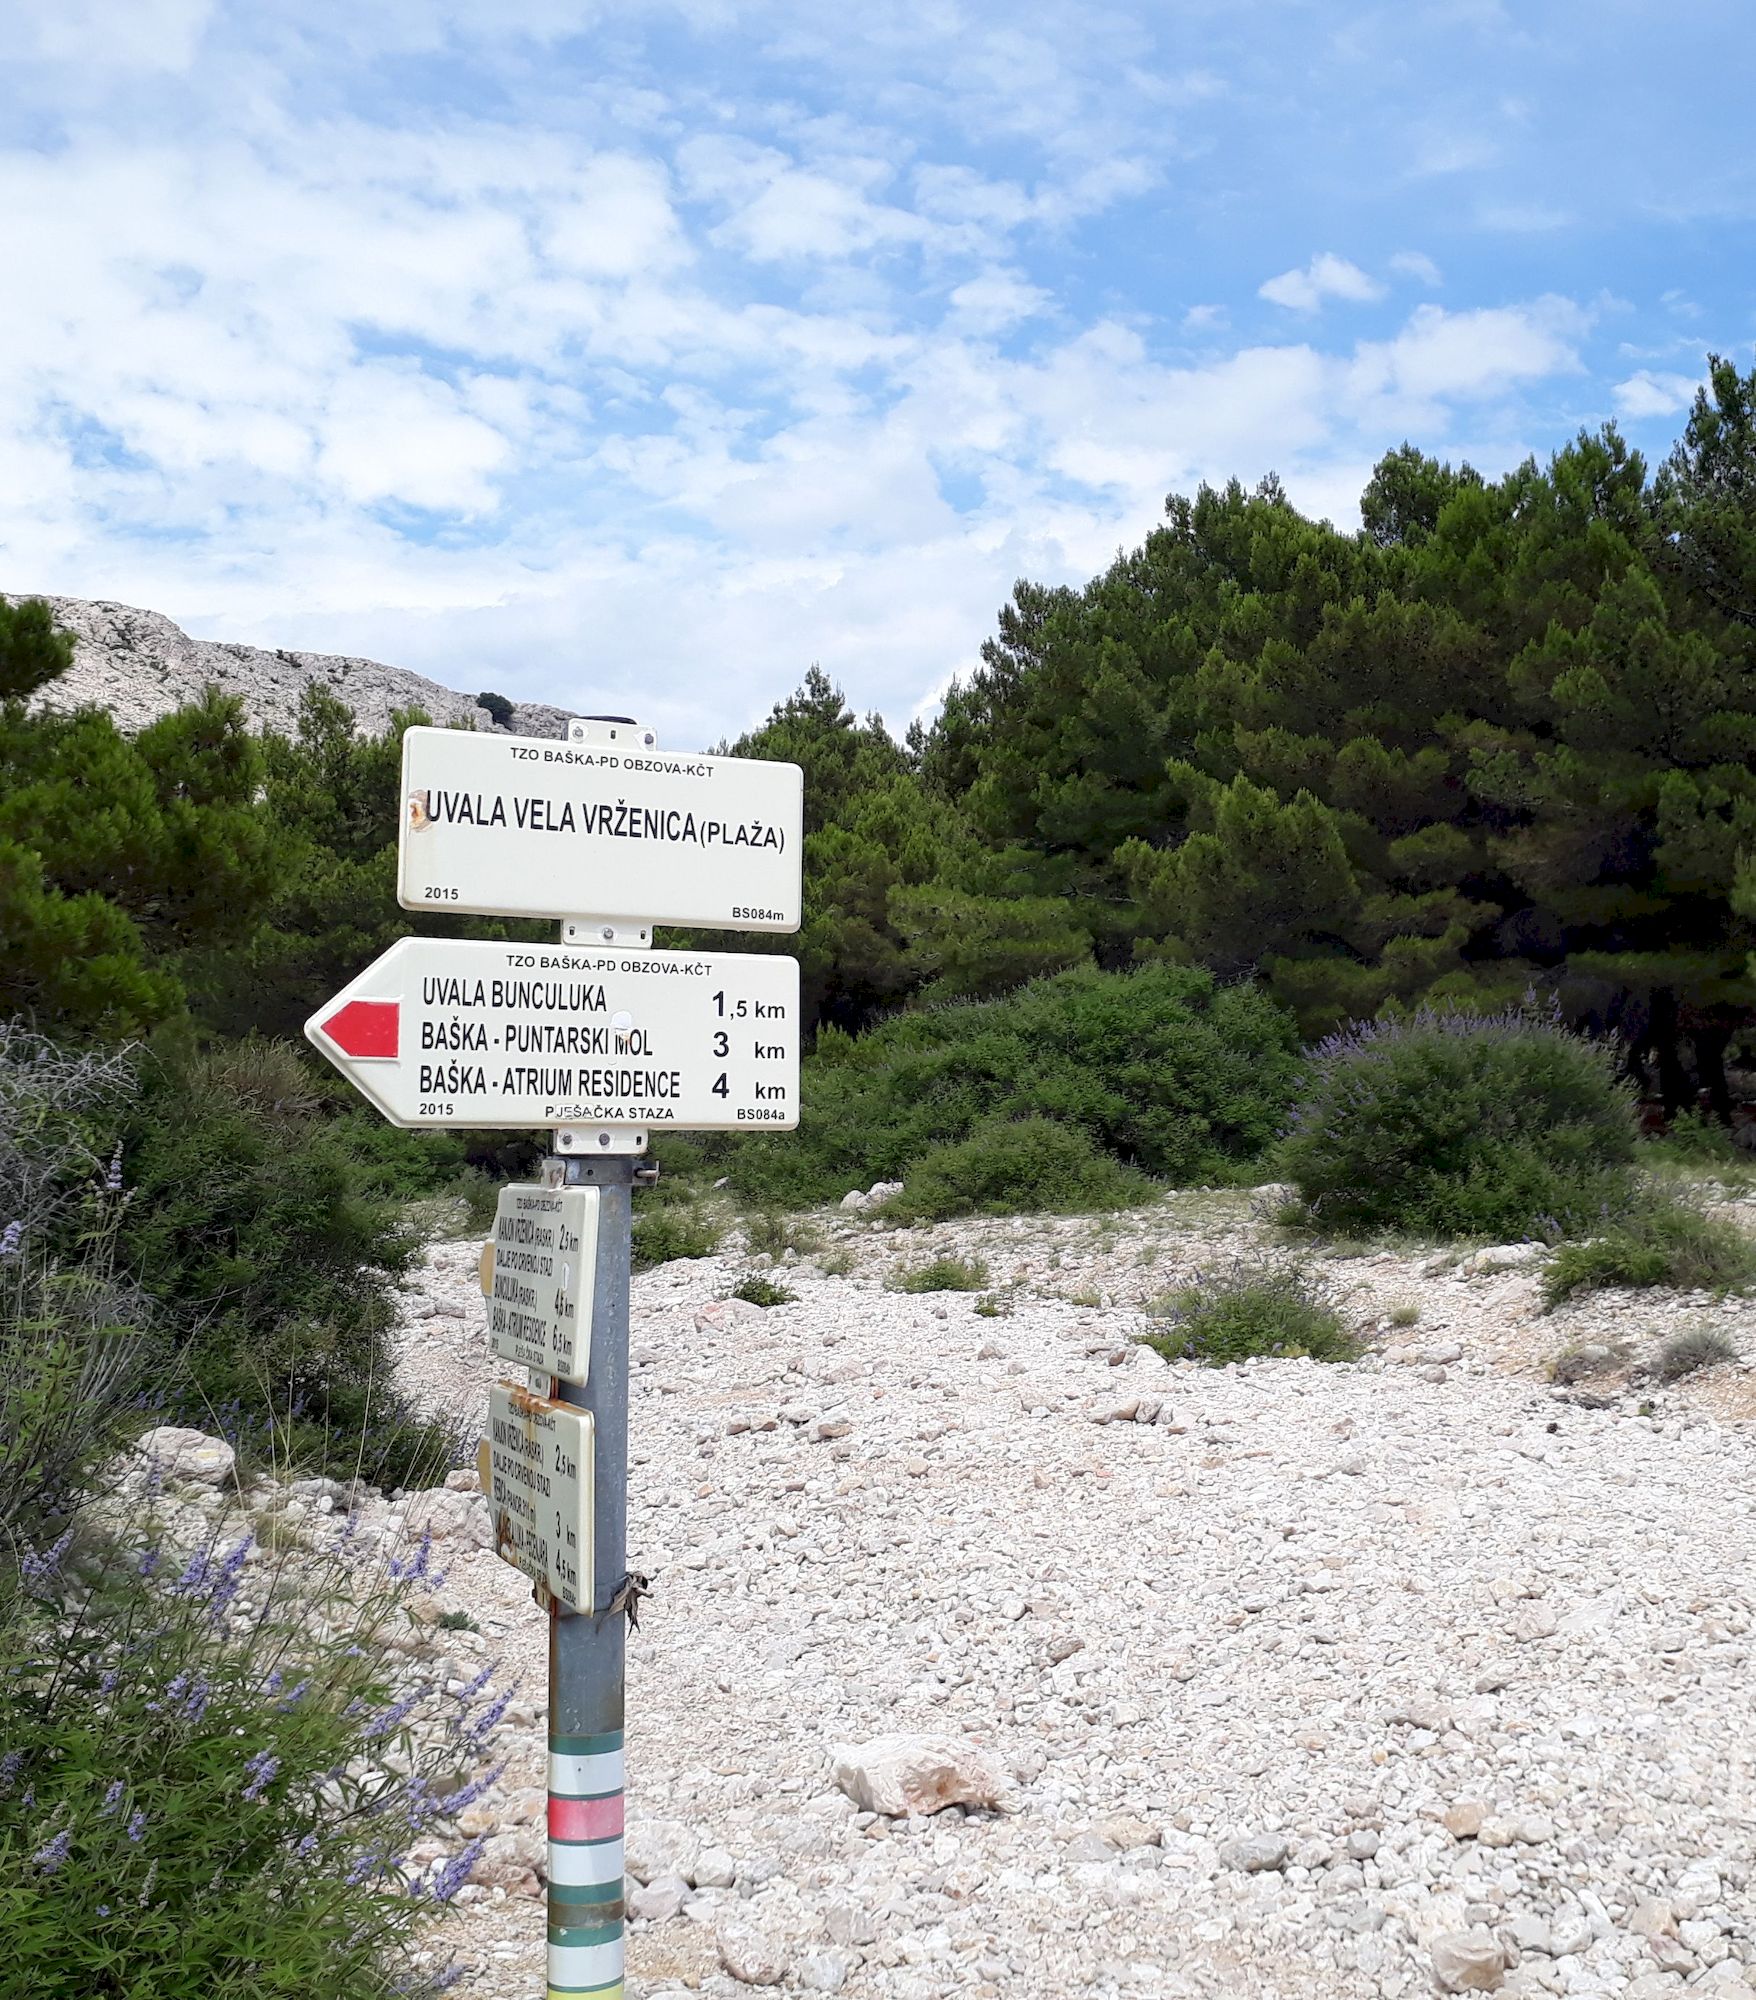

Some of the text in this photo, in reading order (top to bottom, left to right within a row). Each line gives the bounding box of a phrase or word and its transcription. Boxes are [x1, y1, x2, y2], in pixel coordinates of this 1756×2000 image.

[510, 747, 714, 777] TZO BAŠKA-PD OBZOVA-KČT
[425, 789, 507, 828] UVALA
[513, 797, 576, 833] VELA
[424, 886, 459, 900] 2015
[732, 906, 784, 921] BS084m
[506, 954, 713, 976] TZO BAŠKA-PD OBZOVA-KČT
[423, 976, 785, 1021] UVALA BUNCULUKA 1,5 km
[421, 1015, 489, 1052] BAŠKA
[505, 1024, 609, 1055] PUNTARSKI
[713, 1031, 730, 1058] 3
[754, 1041, 785, 1060] km
[419, 1058, 487, 1095] BAŠKA
[502, 1067, 572, 1096] ATRIUM
[578, 1069, 681, 1098] RESIDENCE
[711, 1072, 730, 1099] 4
[755, 1081, 786, 1100] km
[419, 1102, 454, 1116] 2015
[545, 1104, 675, 1120] PJEŠAČKA STAZA
[737, 1108, 785, 1120] BS084a
[569, 1231, 579, 1253] km
[564, 1296, 574, 1319] km
[563, 1334, 572, 1356] km
[555, 1443, 566, 1477] 2,5
[566, 1456, 577, 1480] km
[555, 1510, 561, 1539] 3
[566, 1523, 576, 1549] km
[555, 1548, 566, 1581] 4,5
[566, 1561, 577, 1587] km
